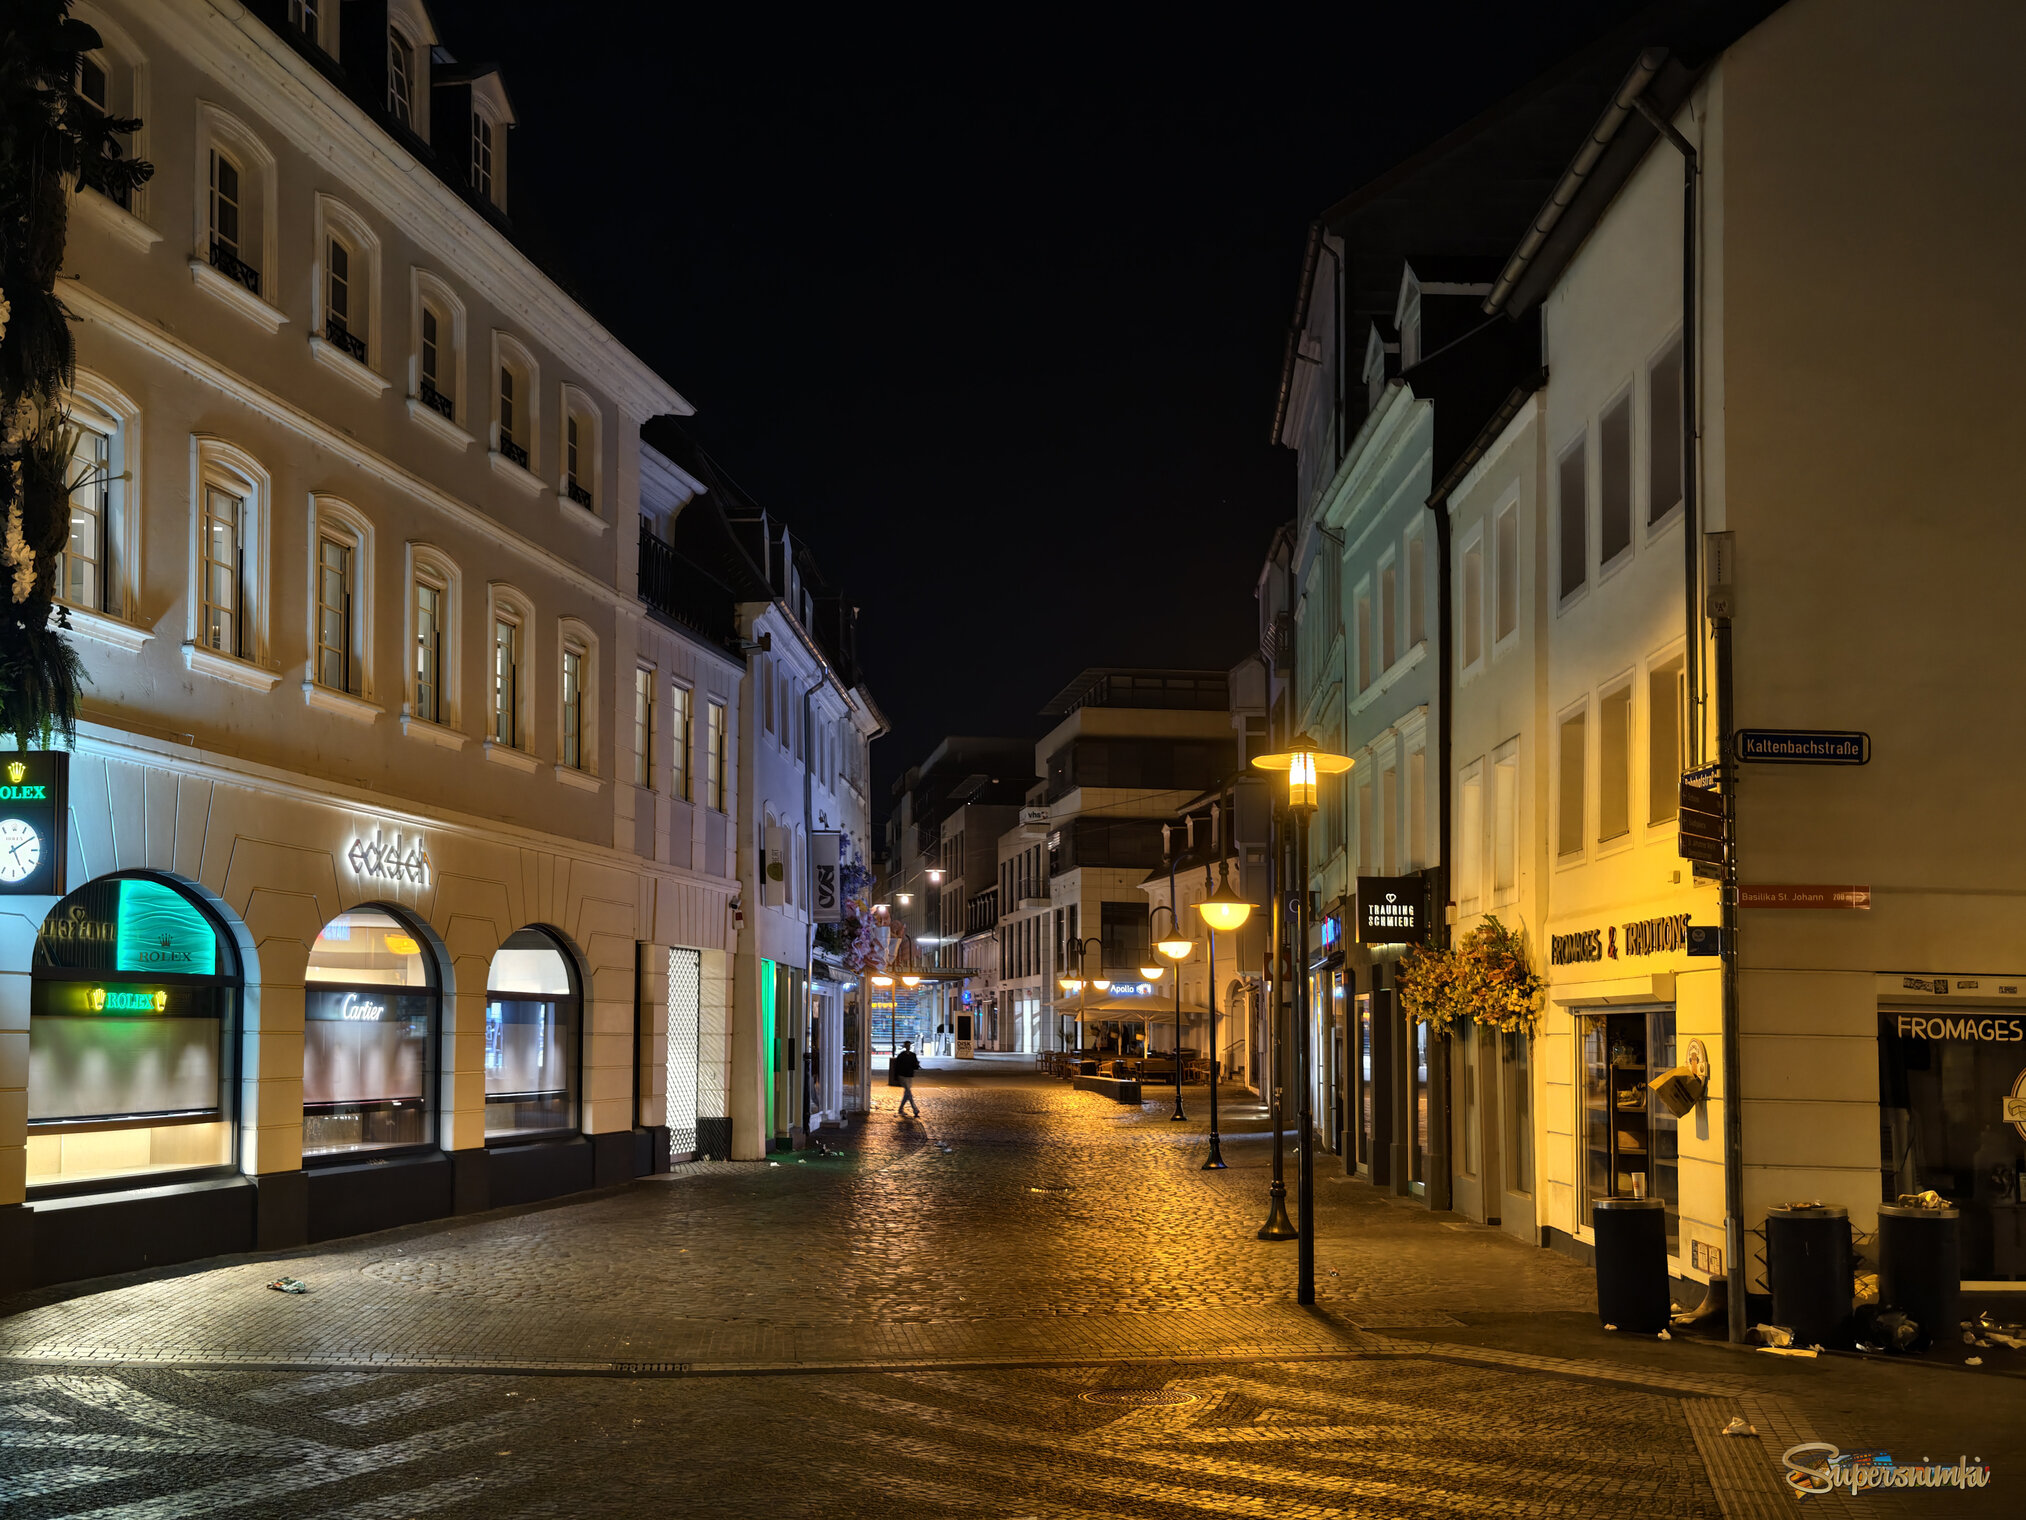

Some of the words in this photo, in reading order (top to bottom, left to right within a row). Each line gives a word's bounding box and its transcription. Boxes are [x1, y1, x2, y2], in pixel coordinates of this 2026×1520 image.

[1746, 738, 1859, 756] Kaltenbachstraße
[0, 785, 46, 799] OLEX
[1028, 811, 1041, 819] vhs
[1741, 892, 1776, 901] Basilika
[1791, 892, 1824, 901] Johann
[1832, 893, 1845, 901] 200
[1368, 904, 1415, 916] TRAURING
[1368, 915, 1415, 928] SCHMIEDE
[1551, 928, 1603, 966] FROMAGES
[1607, 926, 1619, 960] &
[1622, 913, 1692, 956] TRADITIONS
[139, 951, 192, 962] ROLEX
[1110, 984, 1134, 994] Apollo
[106, 992, 155, 1010] ROLEX
[343, 992, 385, 1021] Cartier
[1897, 1015, 2024, 1042] FROMAGES
